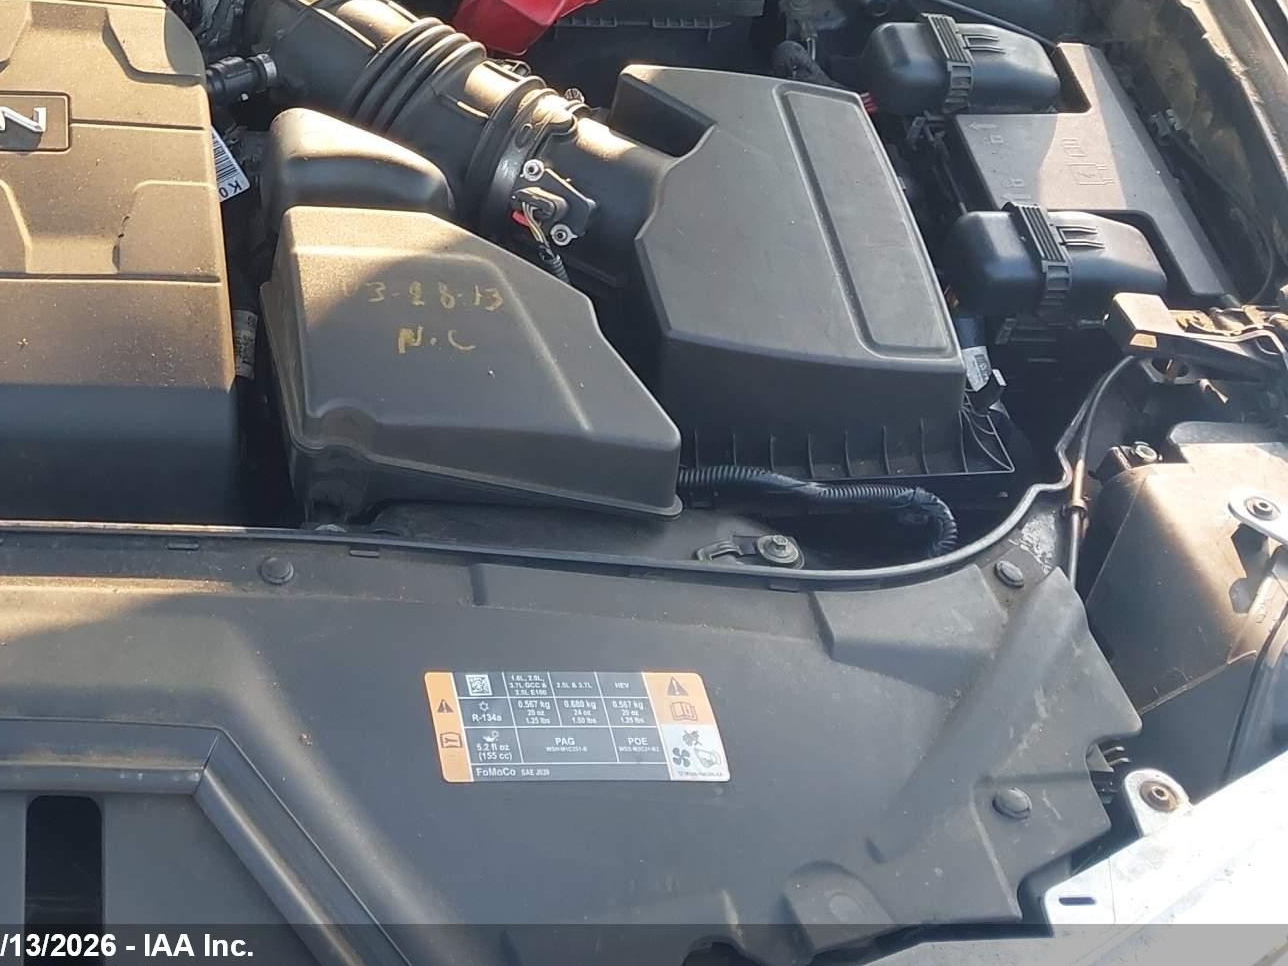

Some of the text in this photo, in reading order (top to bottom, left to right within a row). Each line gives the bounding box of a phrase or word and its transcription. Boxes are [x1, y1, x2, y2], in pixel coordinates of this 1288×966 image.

[539, 700, 551, 710] kg
[585, 700, 597, 710] kg
[632, 700, 644, 710] kg
[471, 714, 503, 722] R-134a
[554, 737, 576, 746] PAG
[627, 737, 649, 746] POE
[476, 743, 490, 751] 5.2
[478, 752, 512, 762] (155 cc)
[476, 768, 517, 777] FoMoCo
